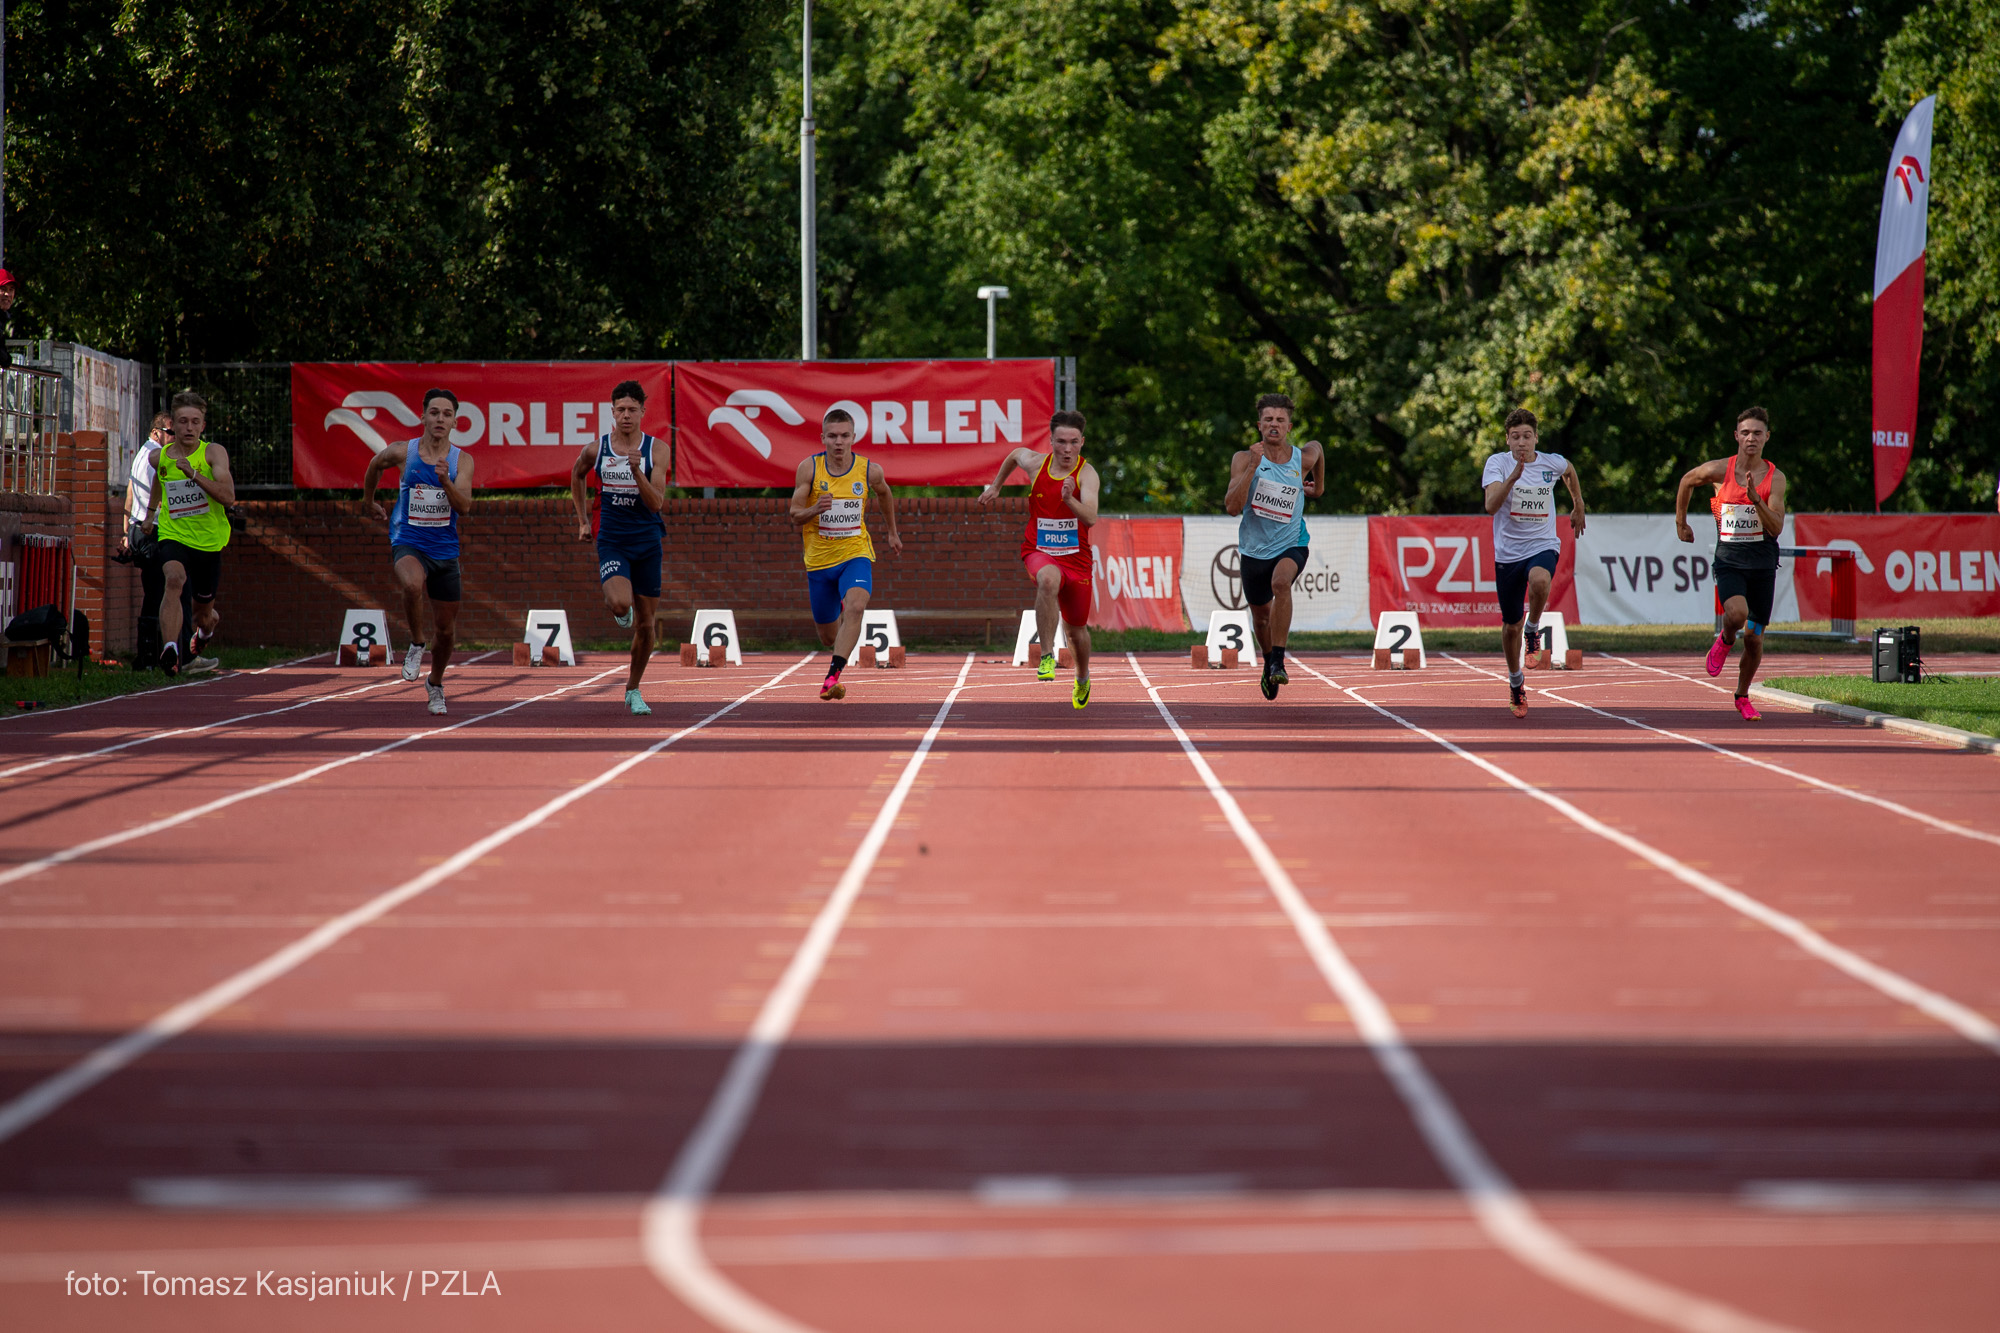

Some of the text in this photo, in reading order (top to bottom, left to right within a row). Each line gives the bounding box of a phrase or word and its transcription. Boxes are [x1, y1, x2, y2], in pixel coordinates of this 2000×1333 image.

[1872, 430, 1909, 447] RLEN
[602, 470, 634, 480] KIERNOŻY
[168, 492, 205, 505] DOŁĘGA
[1281, 486, 1296, 495] 229
[410, 503, 450, 514] BANASZEWSKI
[611, 494, 636, 506] ŻARY
[1254, 492, 1295, 510] DYMIŃSKI
[1521, 500, 1545, 510] PRYK
[820, 513, 861, 523] KRAKOWSKI
[1744, 507, 1757, 515] 46
[1058, 521, 1074, 529] 570
[1726, 519, 1759, 528] MAZUR
[1045, 534, 1069, 543] PRUS
[1397, 536, 1497, 592] PZL
[1885, 549, 2000, 593] ORLEN
[1106, 555, 1173, 600] ORLEN
[1294, 564, 1340, 599] kęcie
[1600, 555, 1716, 593] TVP SP
[352, 622, 377, 652] 8
[537, 623, 561, 647] 7
[703, 623, 729, 650] 6
[866, 623, 889, 652] 5
[1218, 624, 1244, 652] 3
[1389, 625, 1412, 653] 2
[1539, 626, 1552, 654] 1
